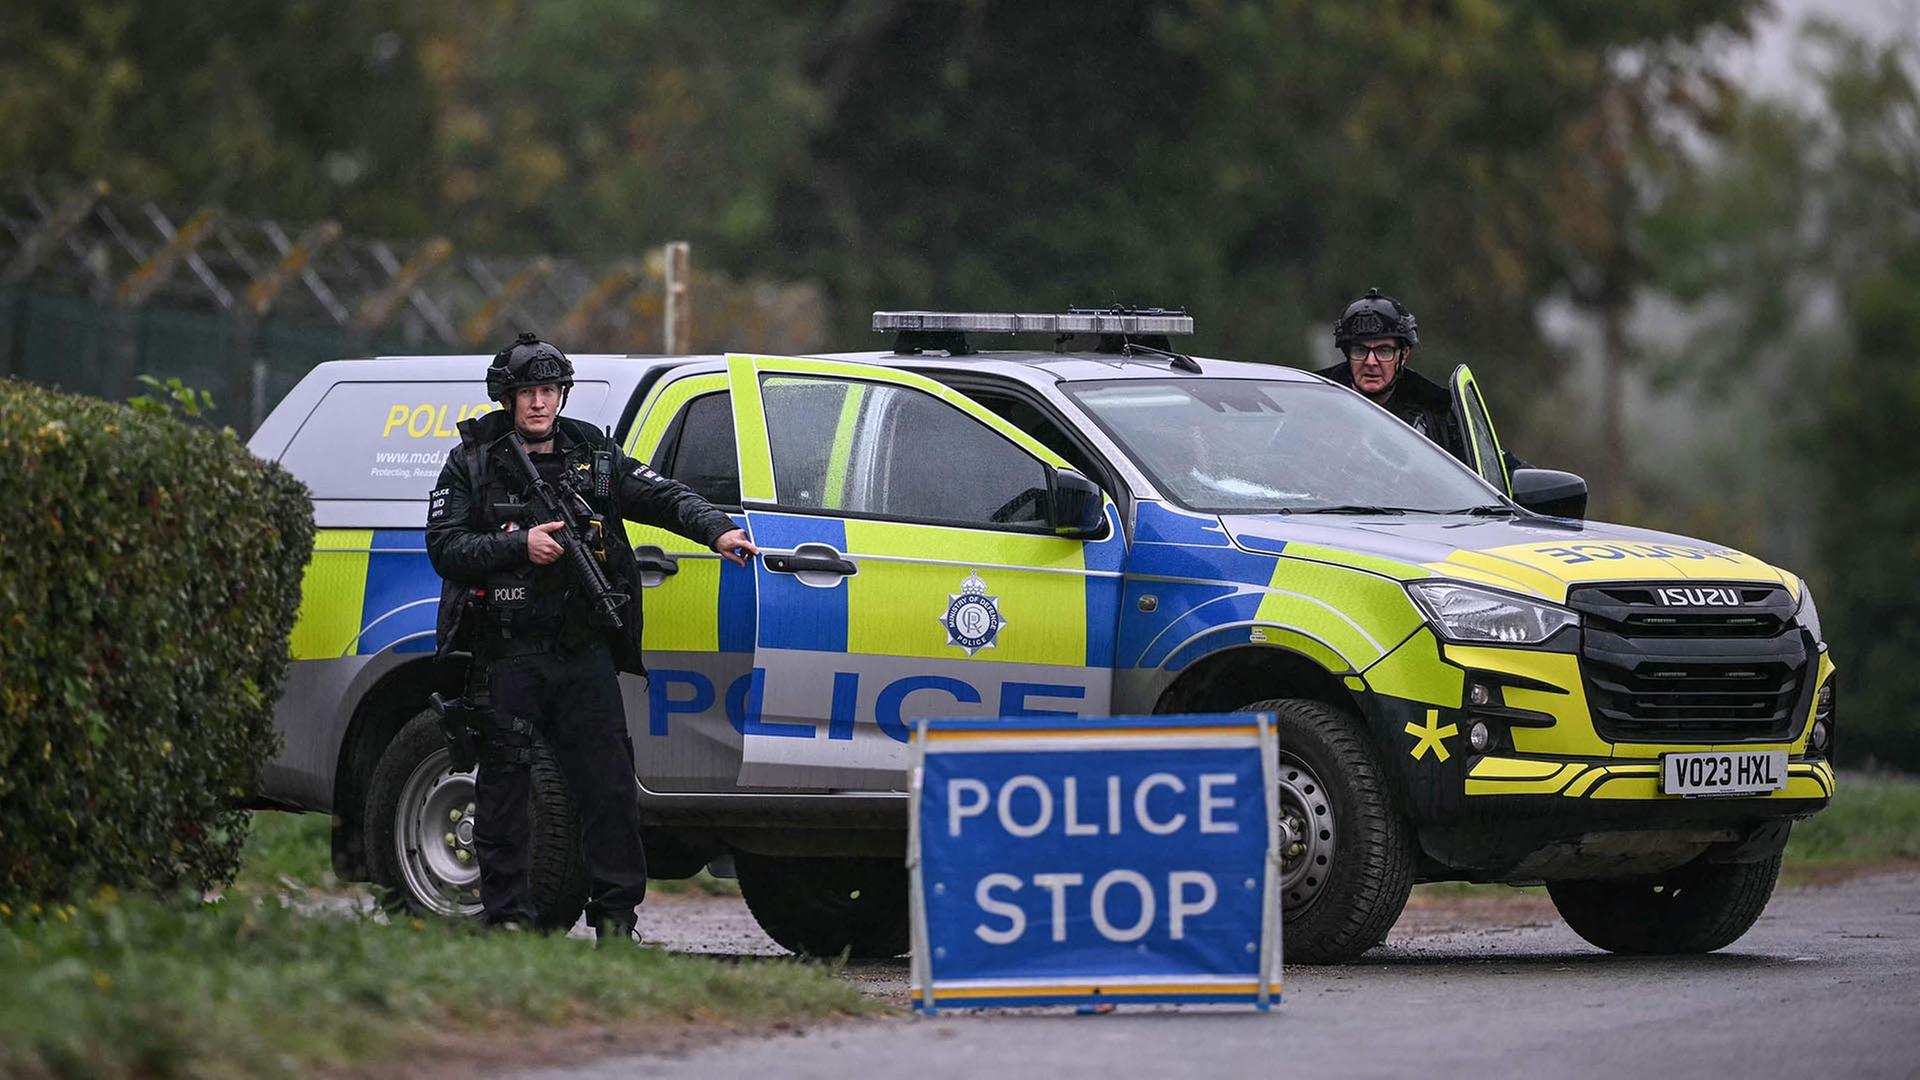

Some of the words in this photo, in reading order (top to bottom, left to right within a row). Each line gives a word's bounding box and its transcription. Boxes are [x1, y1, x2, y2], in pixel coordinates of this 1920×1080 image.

[383, 403, 504, 438] POLI
[494, 587, 526, 601] POLICE
[1657, 588, 1740, 606] ISUZU
[949, 597, 967, 628] MINISTRY
[979, 598, 997, 631] DEFENCE
[957, 635, 986, 646] POLICE
[1737, 755, 1778, 785] HXL
[947, 773, 1239, 838] POLICE
[973, 869, 1218, 945] STOP
